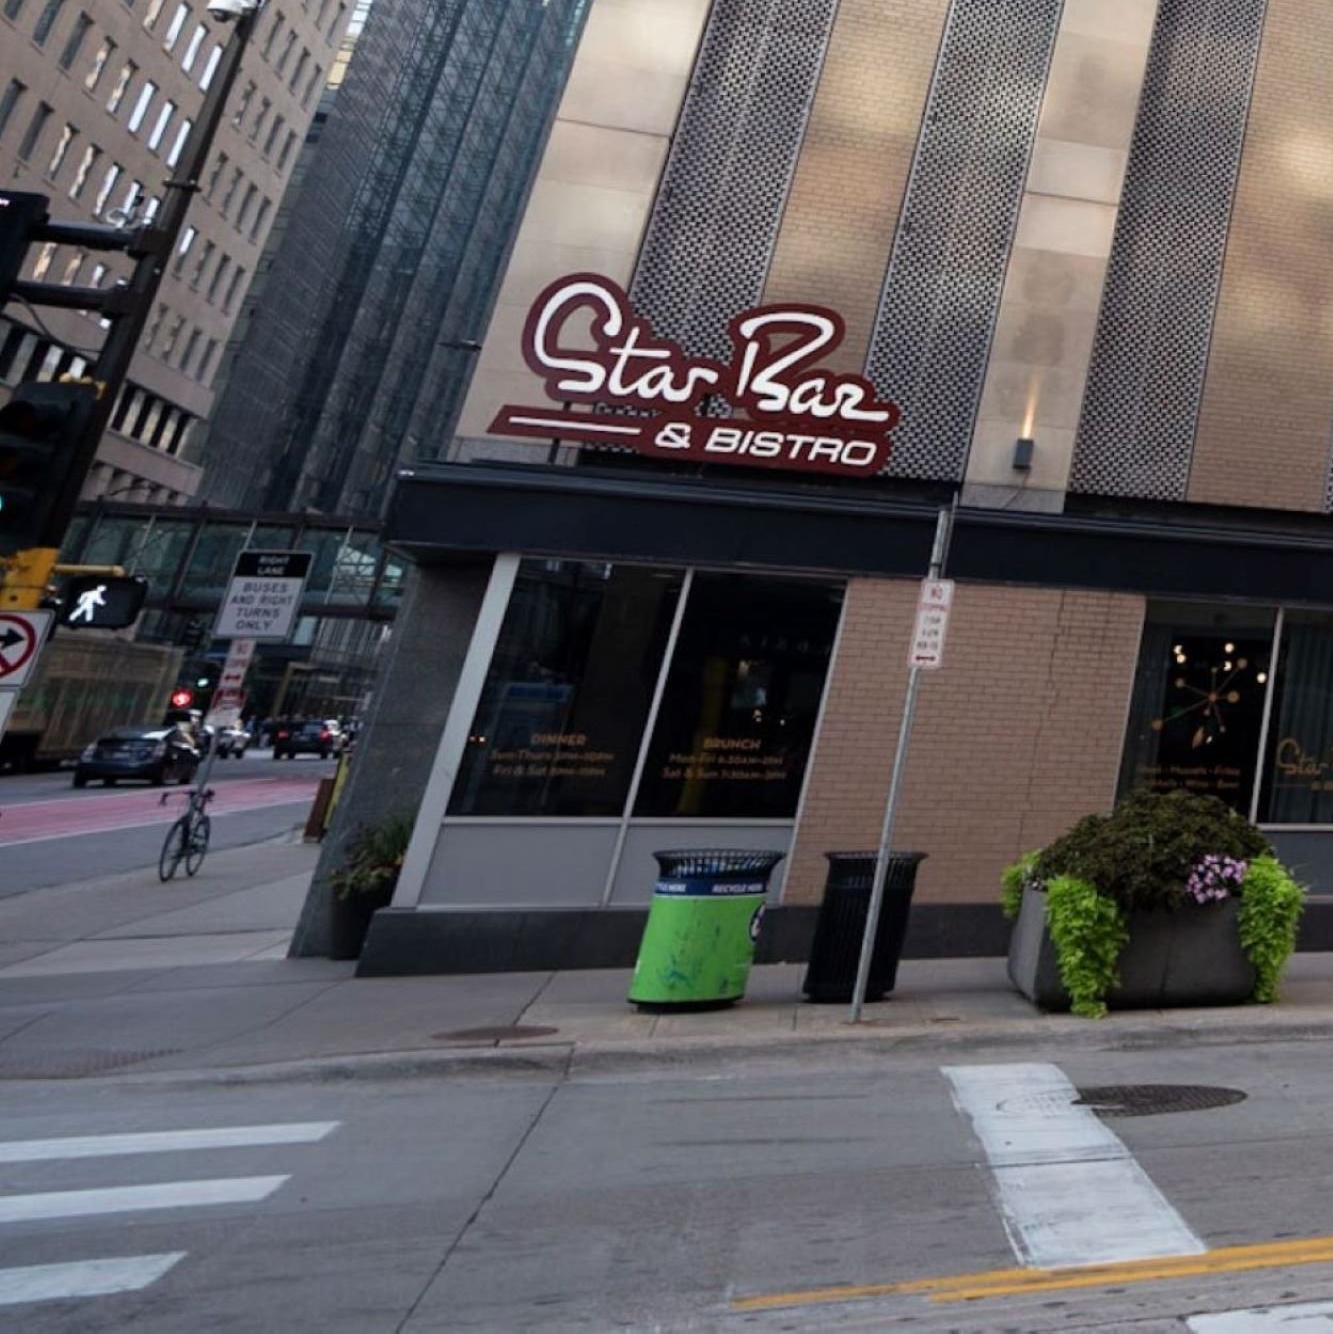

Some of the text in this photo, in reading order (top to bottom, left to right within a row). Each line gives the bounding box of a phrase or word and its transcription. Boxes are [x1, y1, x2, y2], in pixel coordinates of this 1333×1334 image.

[533, 281, 889, 422] Star Bar
[655, 422, 877, 466] & BISTRO
[258, 556, 290, 565] RIGHT
[256, 566, 285, 575] LANE
[243, 582, 288, 593] BUSES
[231, 595, 293, 605] AND RIGHT
[236, 607, 281, 618] TURNS
[235, 620, 273, 631] ONLY
[530, 734, 587, 745] DINNER
[703, 737, 761, 750] BRUNCH
